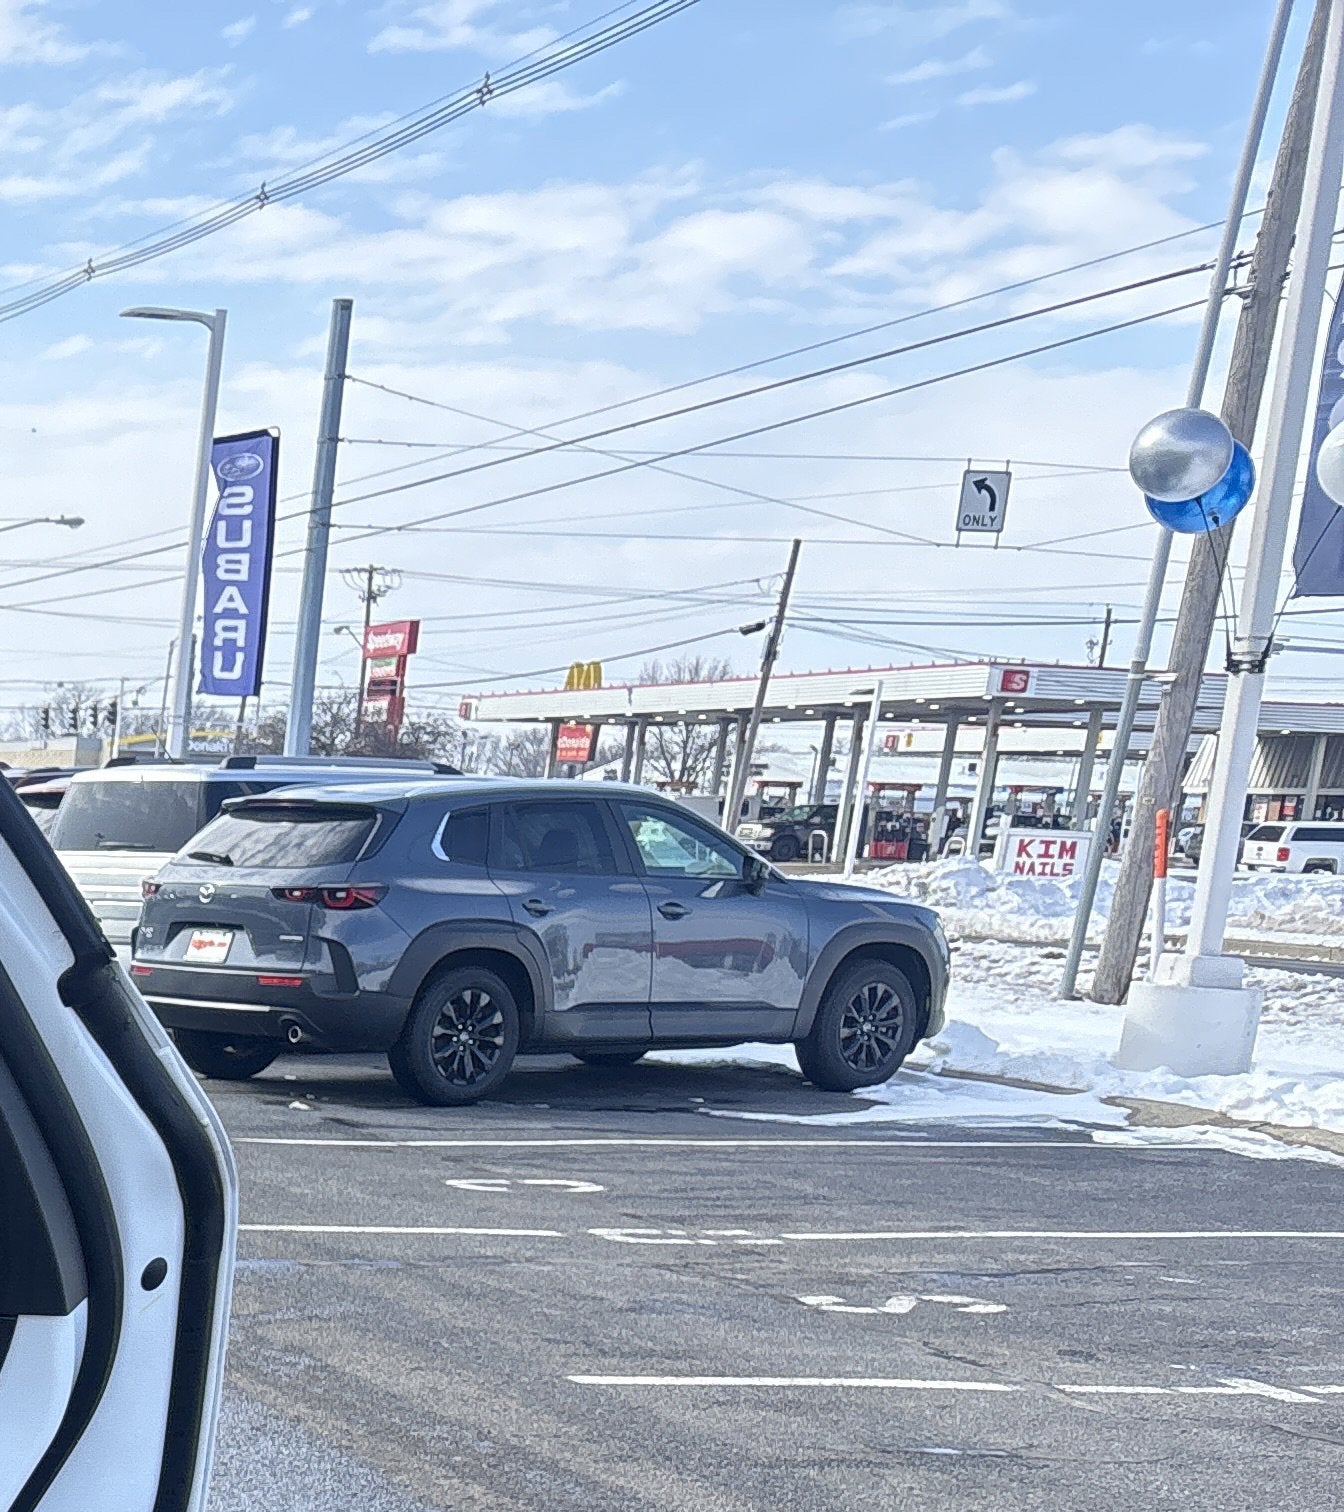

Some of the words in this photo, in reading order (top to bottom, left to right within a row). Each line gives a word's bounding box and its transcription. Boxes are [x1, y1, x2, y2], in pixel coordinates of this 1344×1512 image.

[962, 513, 998, 527] ONLY
[1016, 838, 1078, 860] KIM
[1013, 860, 1075, 877] NAILS
